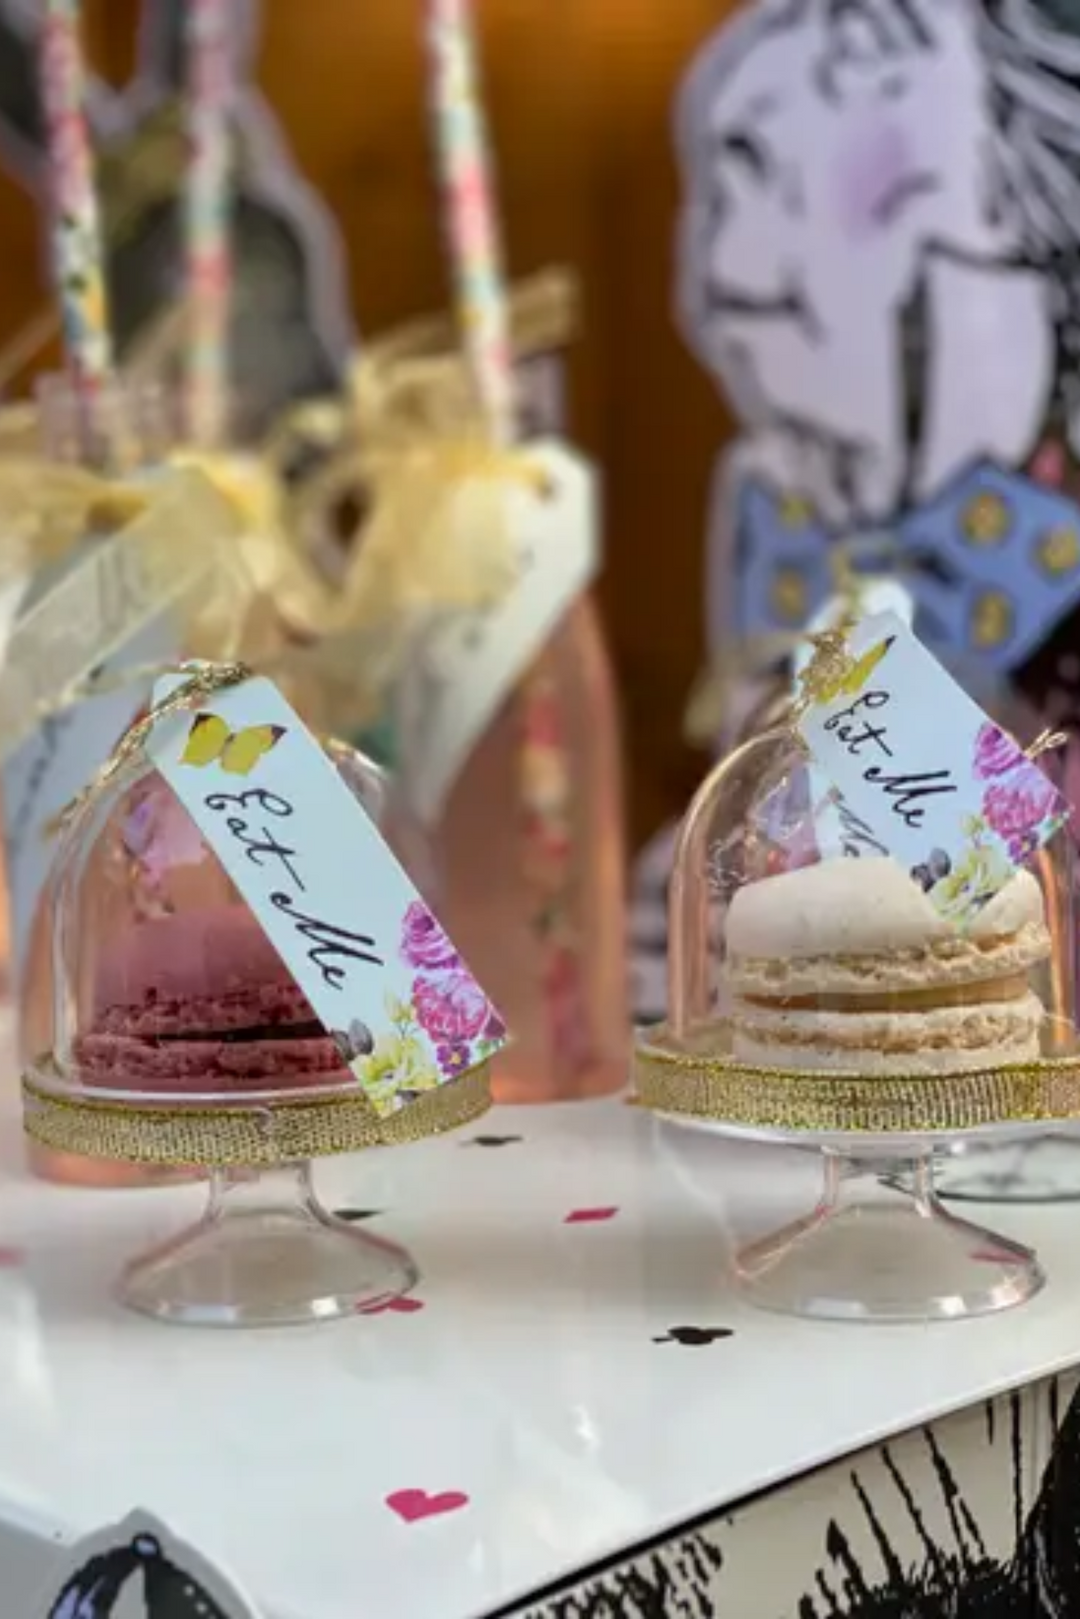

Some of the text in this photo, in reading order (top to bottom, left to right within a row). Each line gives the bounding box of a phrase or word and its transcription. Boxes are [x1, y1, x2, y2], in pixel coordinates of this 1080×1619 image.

[824, 691, 957, 827] Eat Me
[205, 788, 384, 989] Eat Me
